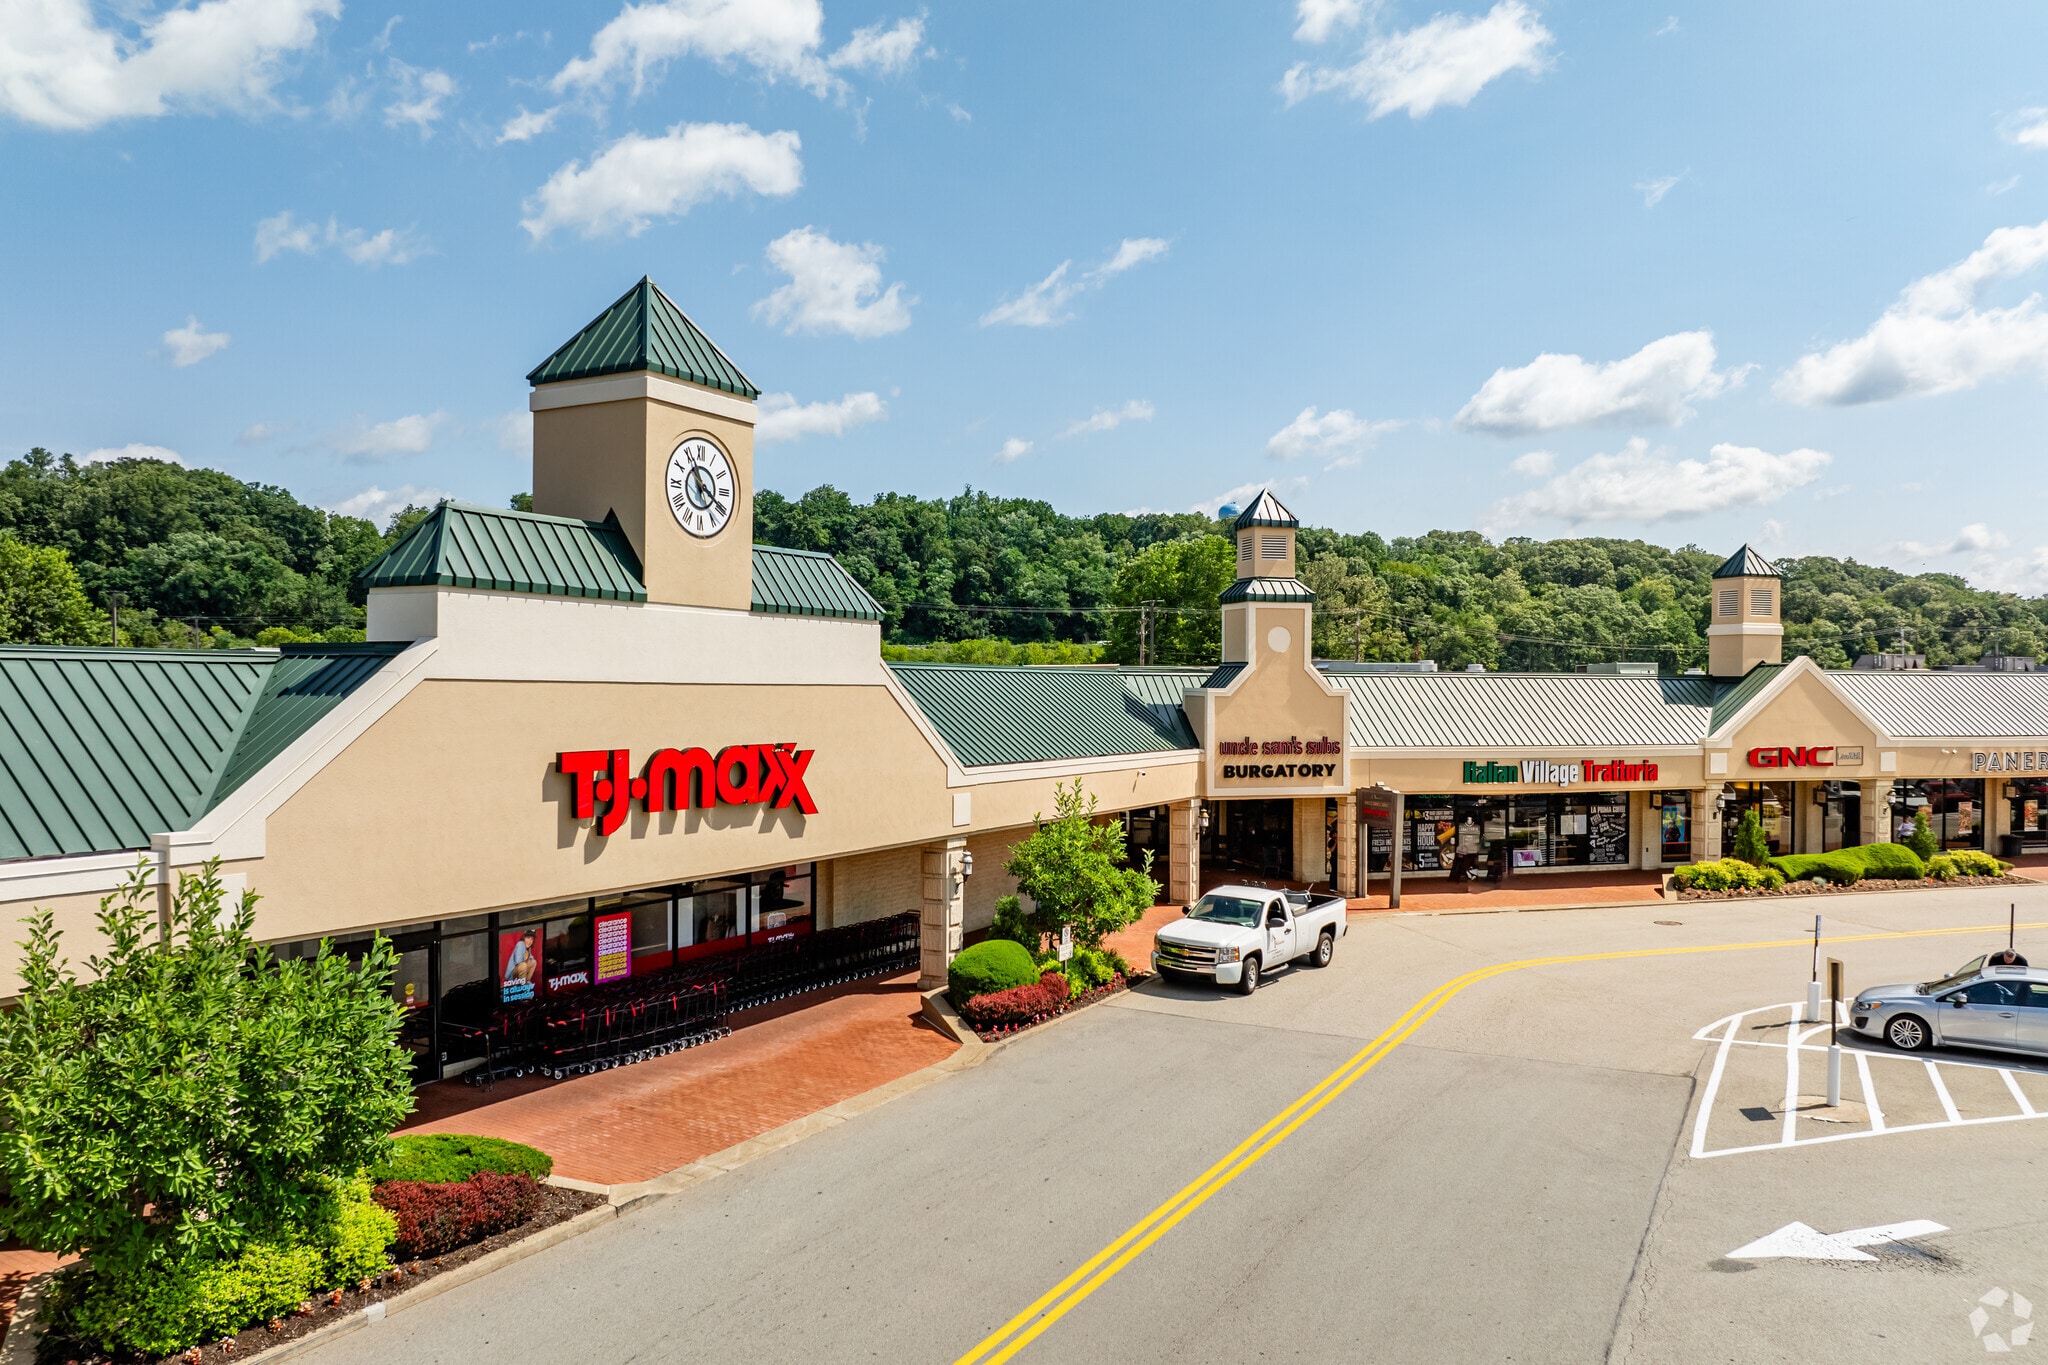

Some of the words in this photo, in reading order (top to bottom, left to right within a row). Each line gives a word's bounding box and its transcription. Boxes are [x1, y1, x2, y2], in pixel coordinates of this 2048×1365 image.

[1220, 736, 1258, 755] uncle
[1262, 736, 1303, 755] sam's
[1306, 736, 1340, 754] subs
[1747, 746, 1834, 768] GNC
[1223, 764, 1336, 778] BURGATORY
[1463, 761, 1518, 784] Italian
[1520, 760, 1579, 787] Village
[1581, 760, 1659, 782] Trattoria
[1417, 823, 1435, 832] HAPPY
[1417, 835, 1435, 846] HOUR
[598, 918, 627, 928] clearance
[598, 923, 627, 933] clearance
[598, 929, 627, 939] clearance
[598, 935, 627, 945] clearance
[598, 941, 627, 950] clearance
[598, 946, 627, 956] clearance
[503, 978, 526, 987] saving
